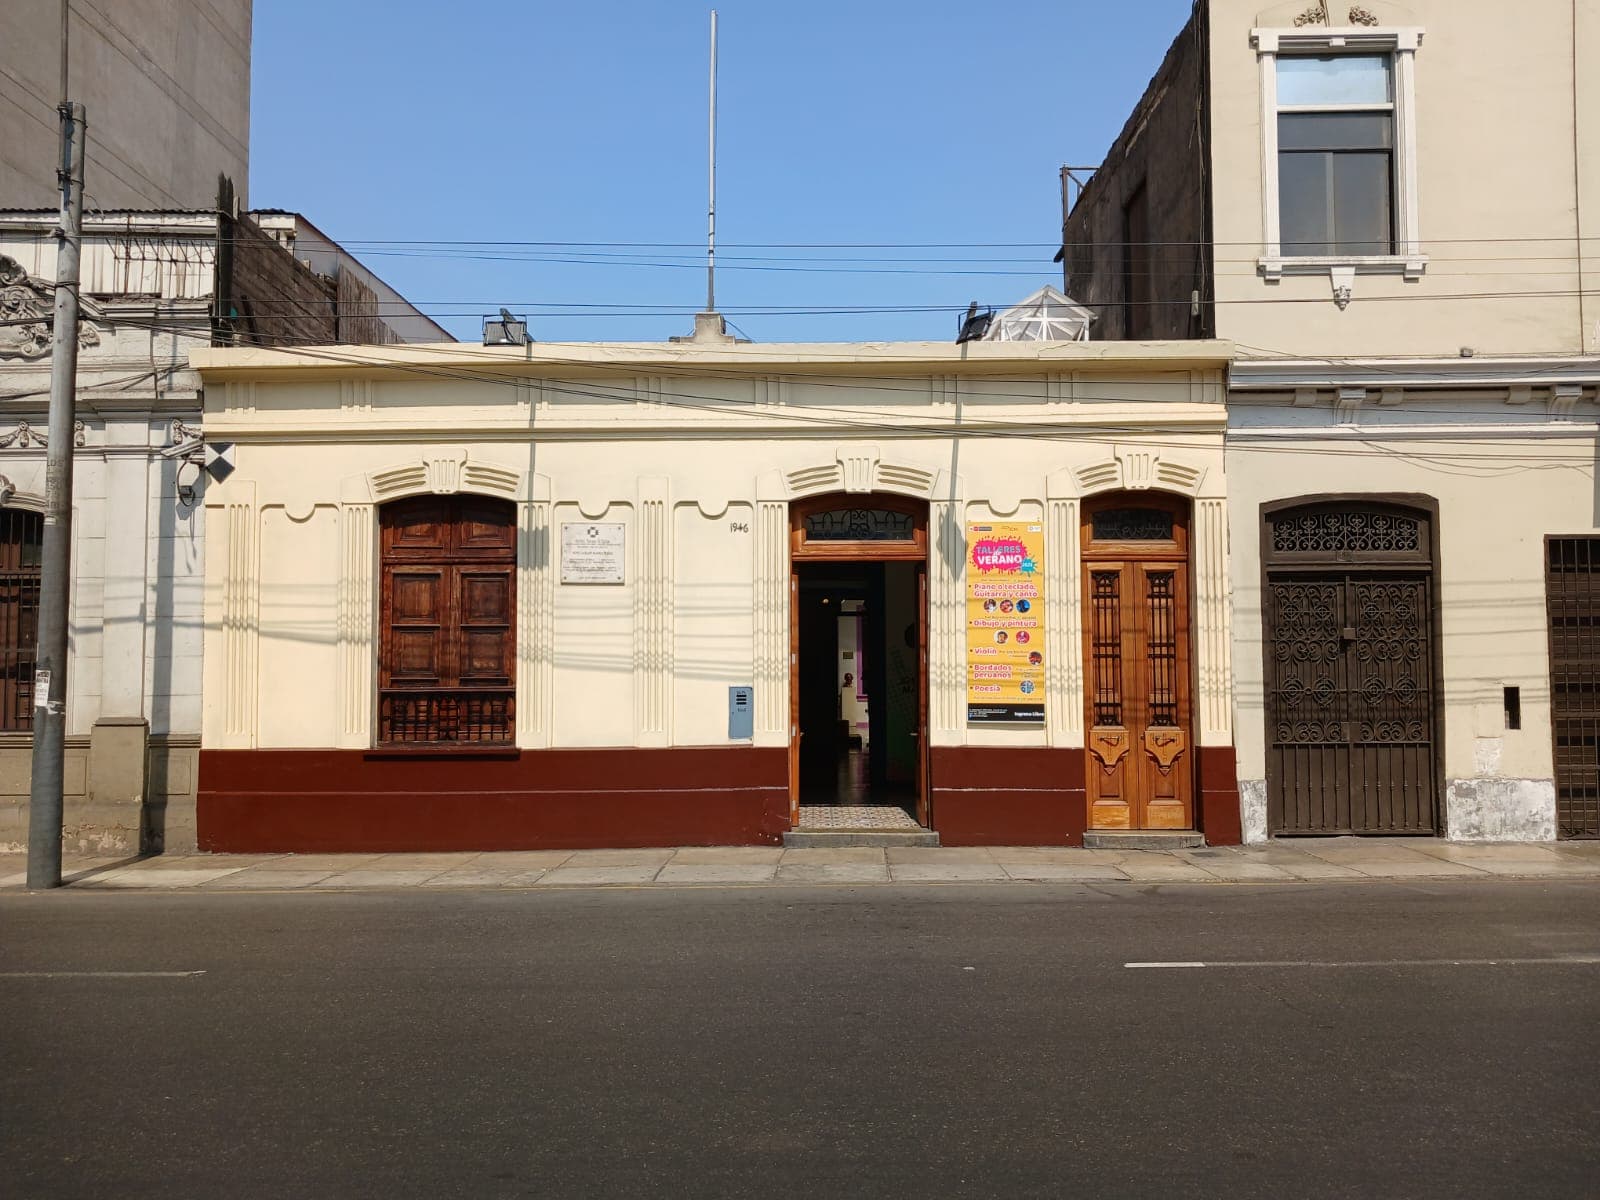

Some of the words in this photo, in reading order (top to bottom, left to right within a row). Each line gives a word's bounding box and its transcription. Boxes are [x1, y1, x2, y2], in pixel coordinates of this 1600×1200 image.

[730, 522, 749, 533] 1946
[977, 545, 1021, 554] TALLERES
[977, 555, 1022, 565] VERANO
